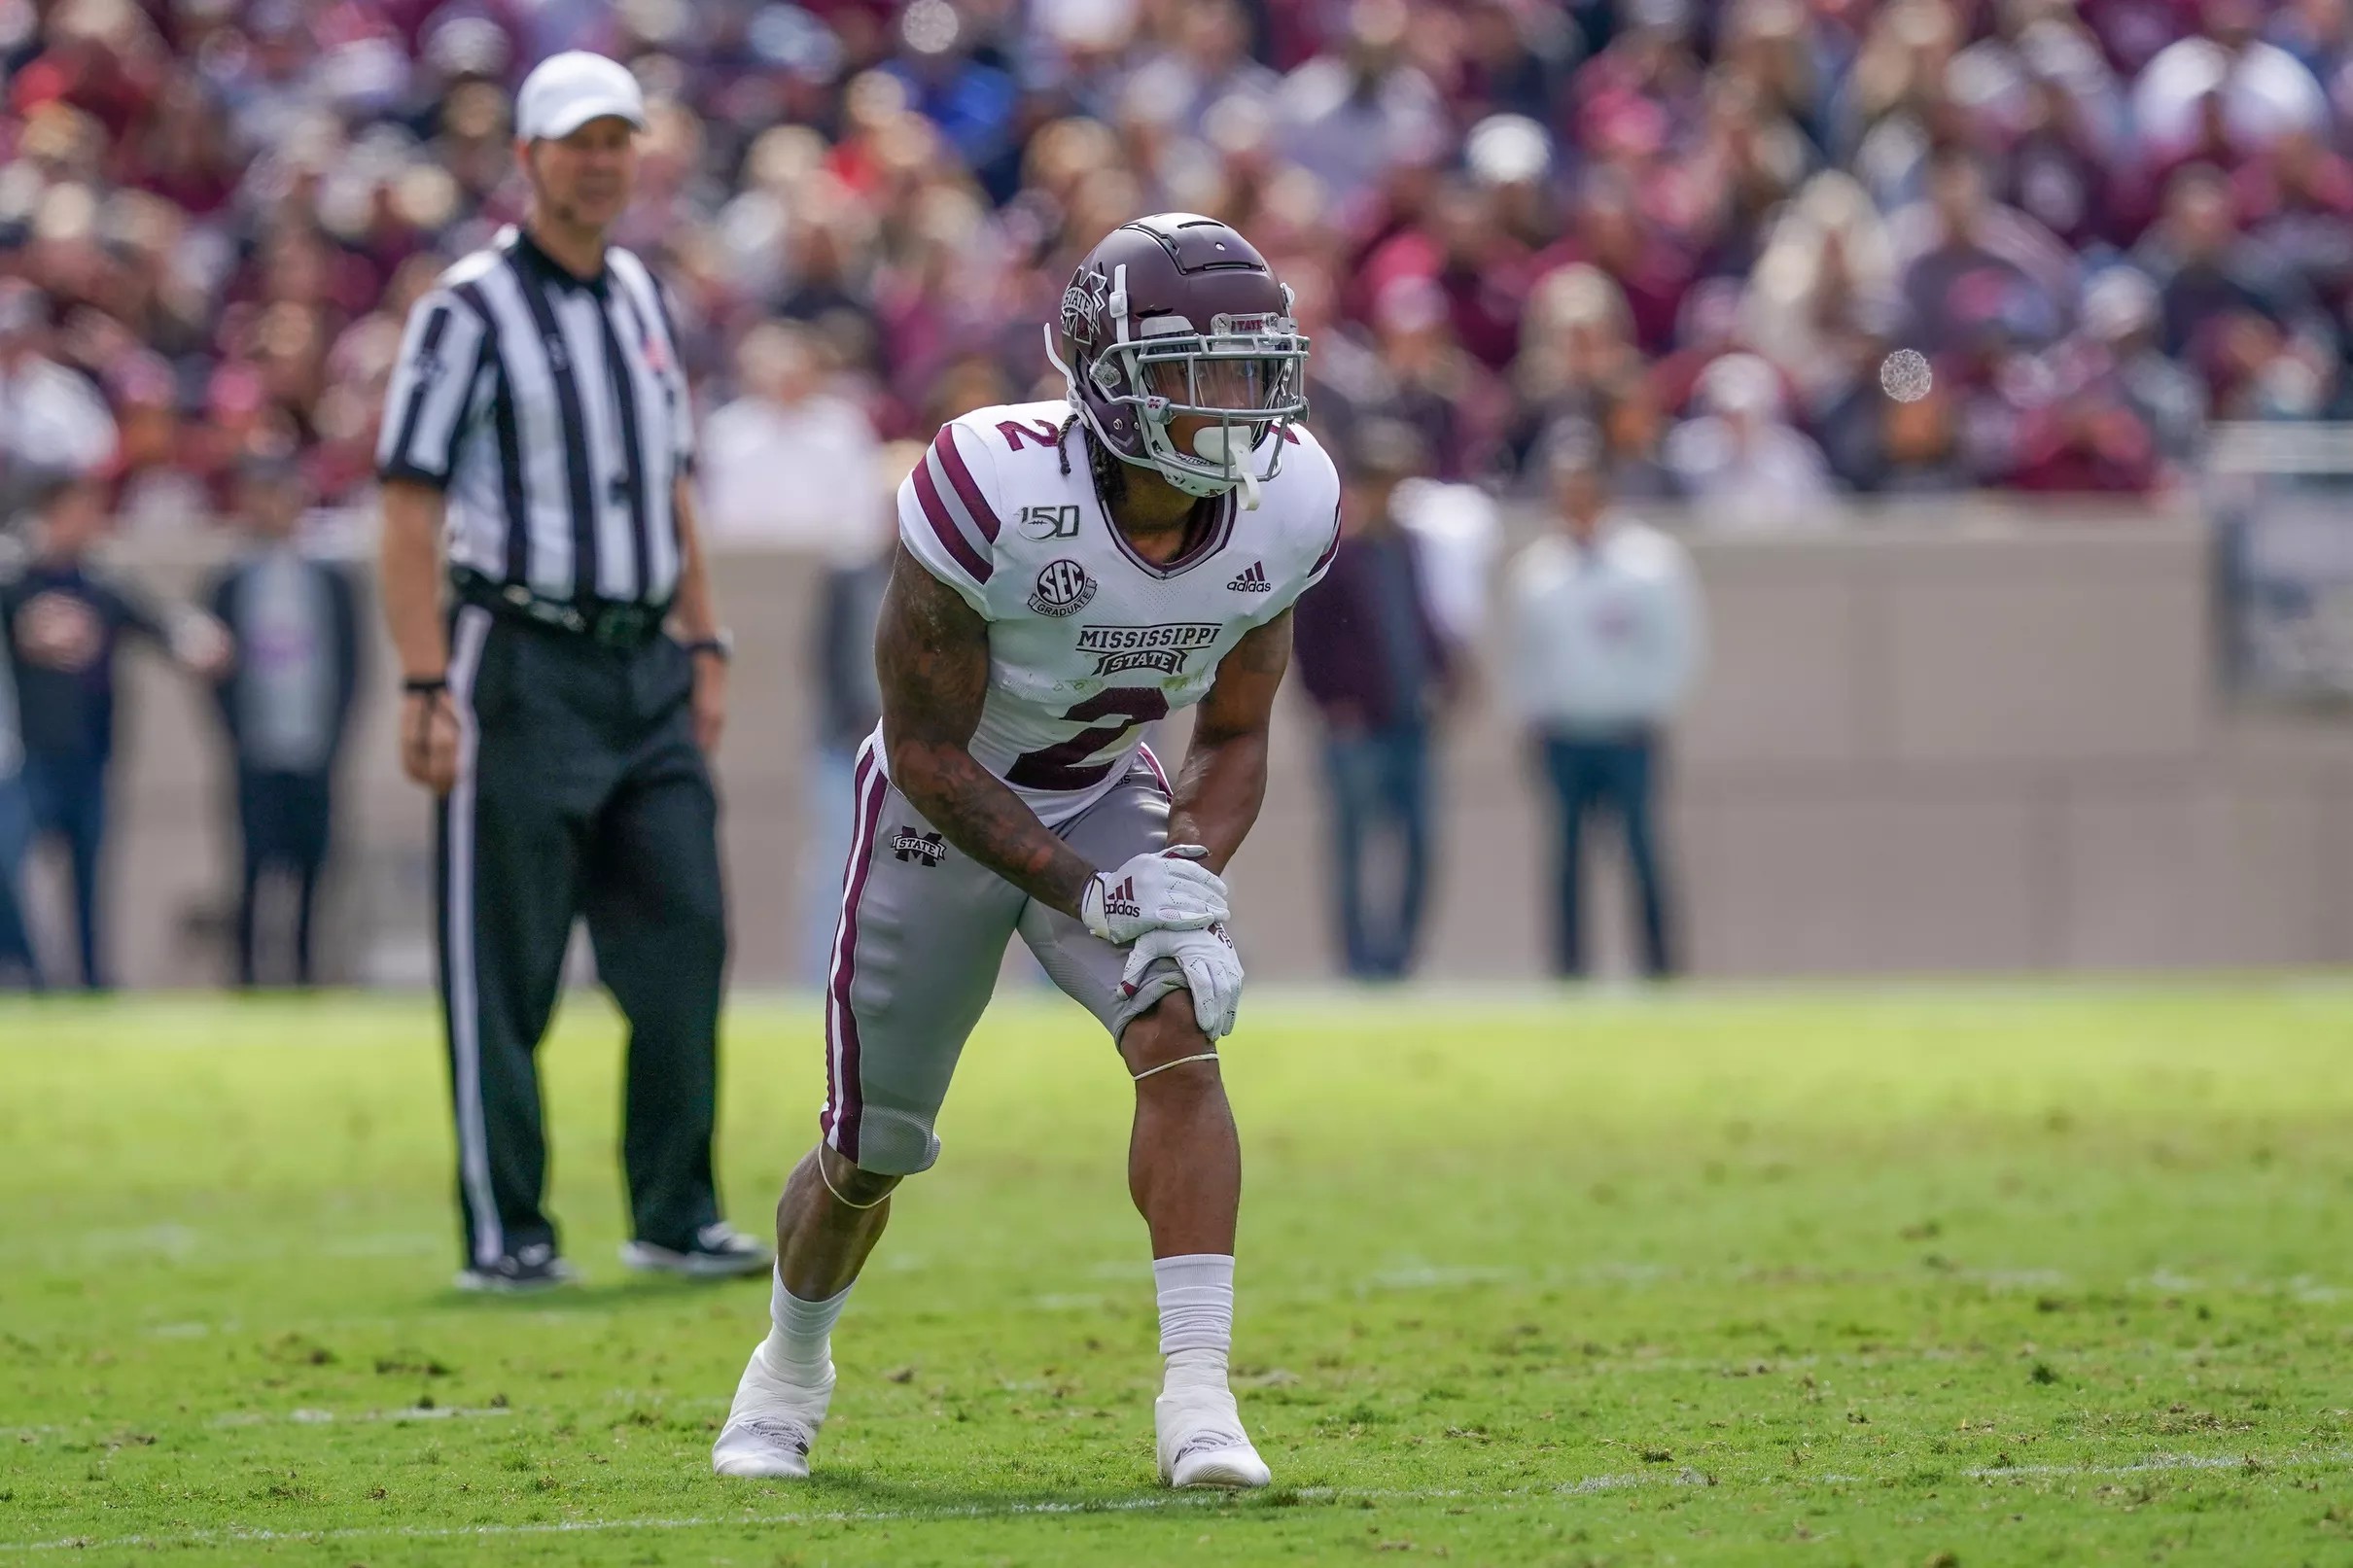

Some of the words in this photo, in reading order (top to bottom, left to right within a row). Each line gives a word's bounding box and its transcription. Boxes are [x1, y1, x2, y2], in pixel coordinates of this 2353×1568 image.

[995, 418, 1059, 451] 2
[1022, 505, 1079, 539] 150
[1038, 560, 1083, 604] SEC
[1226, 580, 1271, 593] adidas
[1036, 592, 1091, 616] GRADUATE
[1076, 627, 1221, 649] MISSISSIPPI
[1110, 651, 1173, 671] STATE
[1004, 686, 1170, 791] 2
[898, 839, 936, 854] STATE
